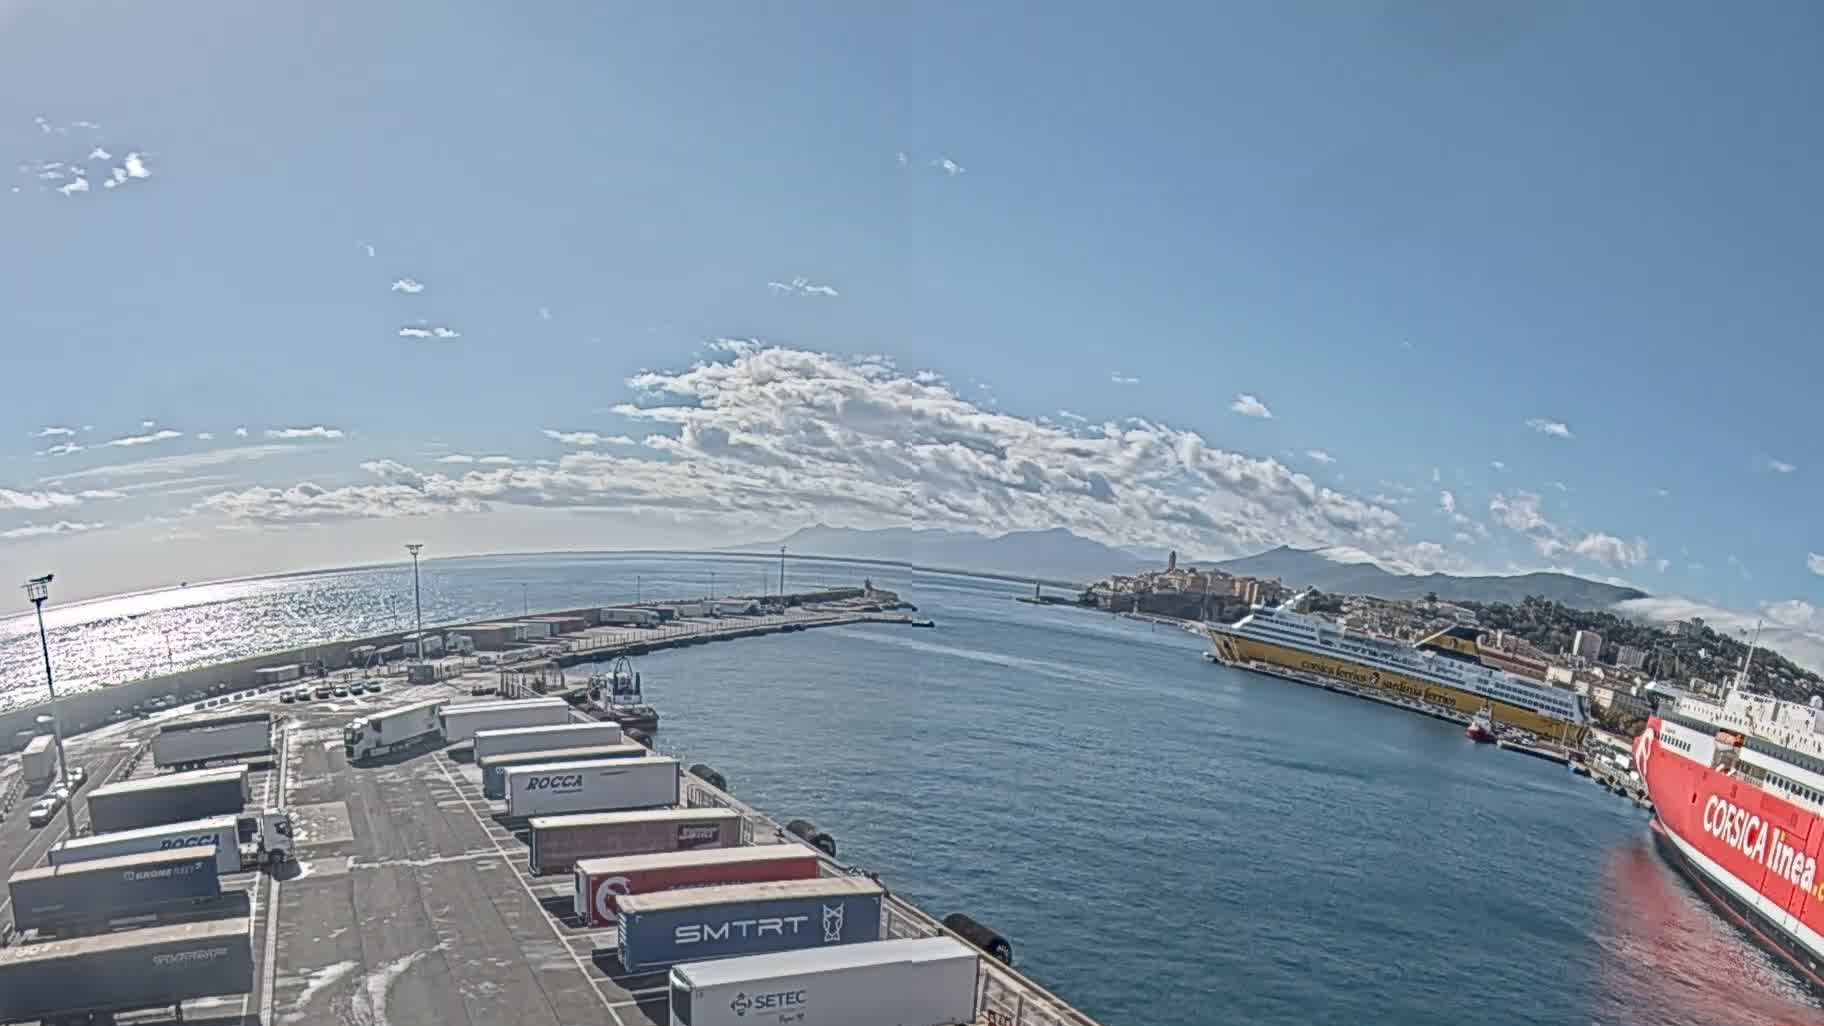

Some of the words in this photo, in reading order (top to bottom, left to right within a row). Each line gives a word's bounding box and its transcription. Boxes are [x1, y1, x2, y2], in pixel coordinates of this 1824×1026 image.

[525, 775, 583, 791] ROCCA
[1703, 794, 1768, 864] CORSICA
[675, 916, 808, 944] SMTRT
[755, 990, 807, 1009] SETEC
